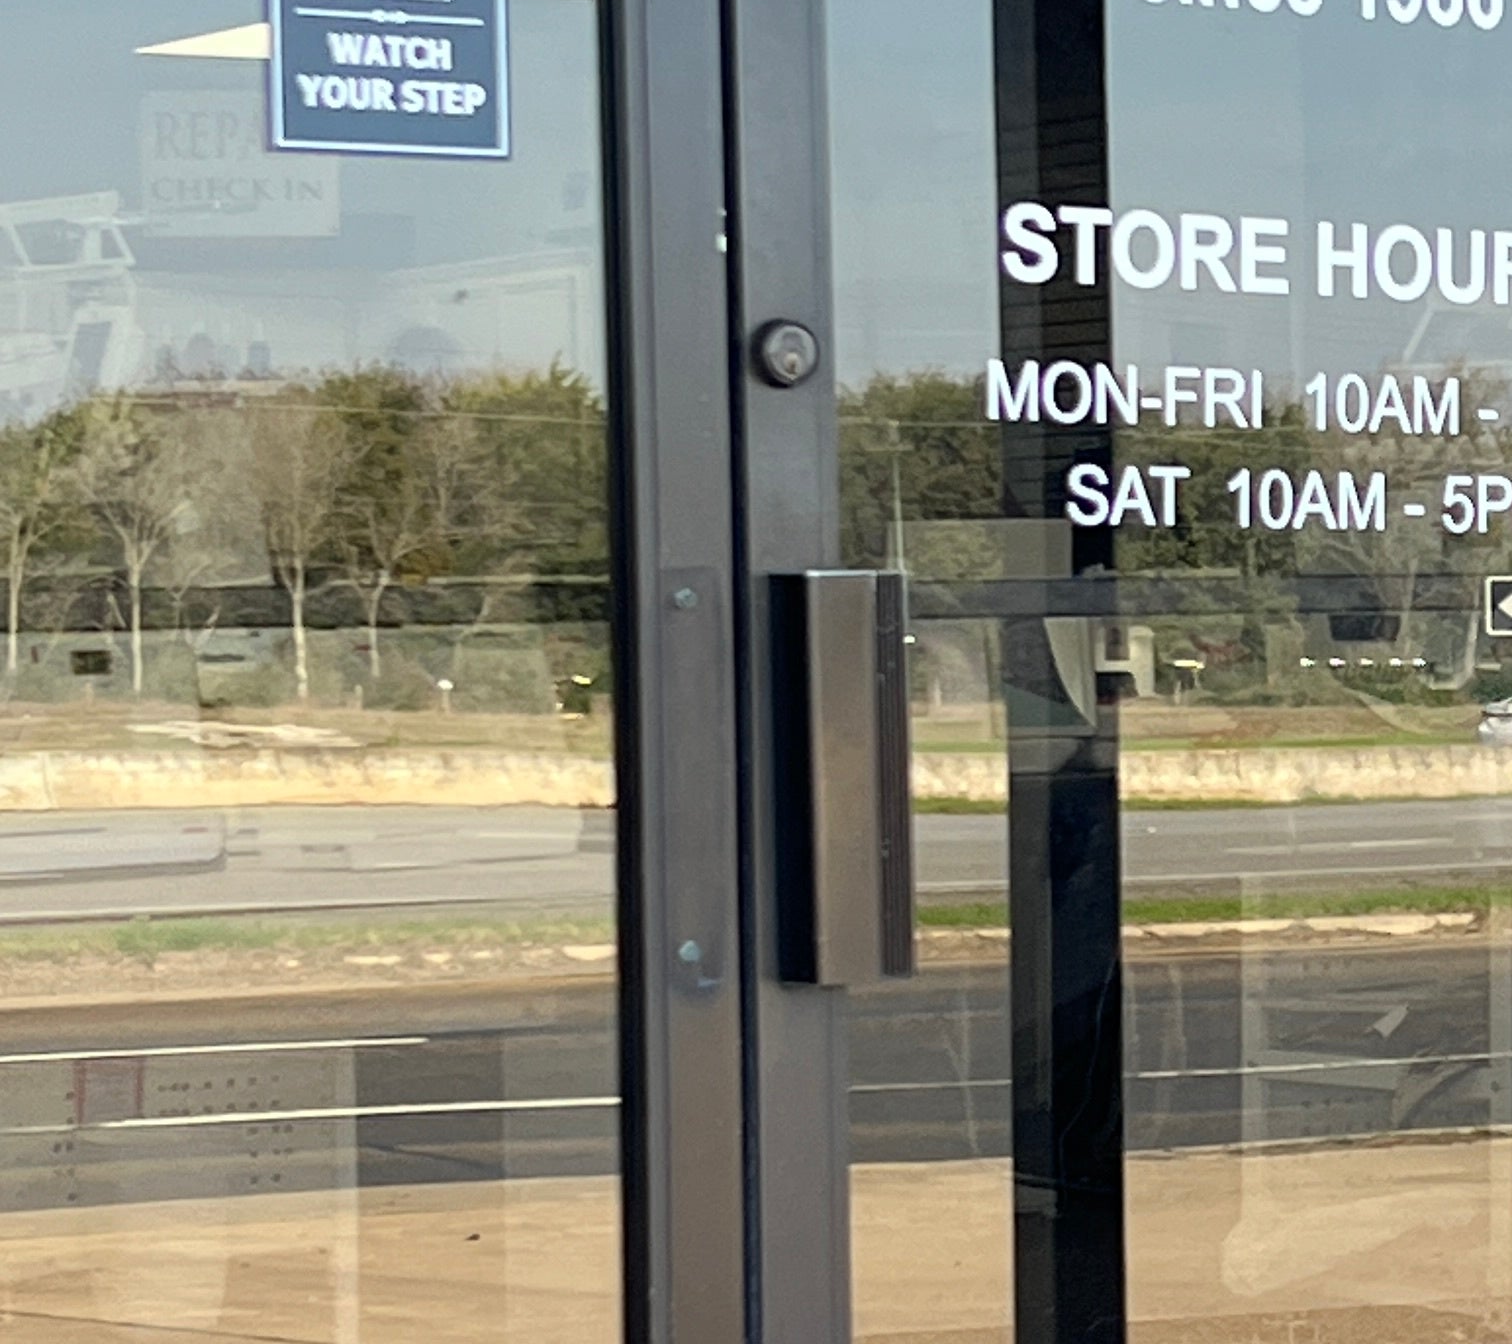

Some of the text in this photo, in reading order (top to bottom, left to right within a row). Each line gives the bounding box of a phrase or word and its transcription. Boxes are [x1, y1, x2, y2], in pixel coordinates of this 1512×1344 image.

[327, 31, 452, 71] WATCH
[296, 74, 487, 116] YOUR STEP
[151, 176, 323, 203] CHECK IN
[1002, 201, 1289, 295] STORE
[985, 360, 1264, 429] MON-FRI
[1305, 372, 1461, 435] 10AM
[1477, 407, 1500, 423] -
[1065, 464, 1190, 527] SAT
[1227, 469, 1387, 531] 10AM
[1403, 503, 1425, 518] -
